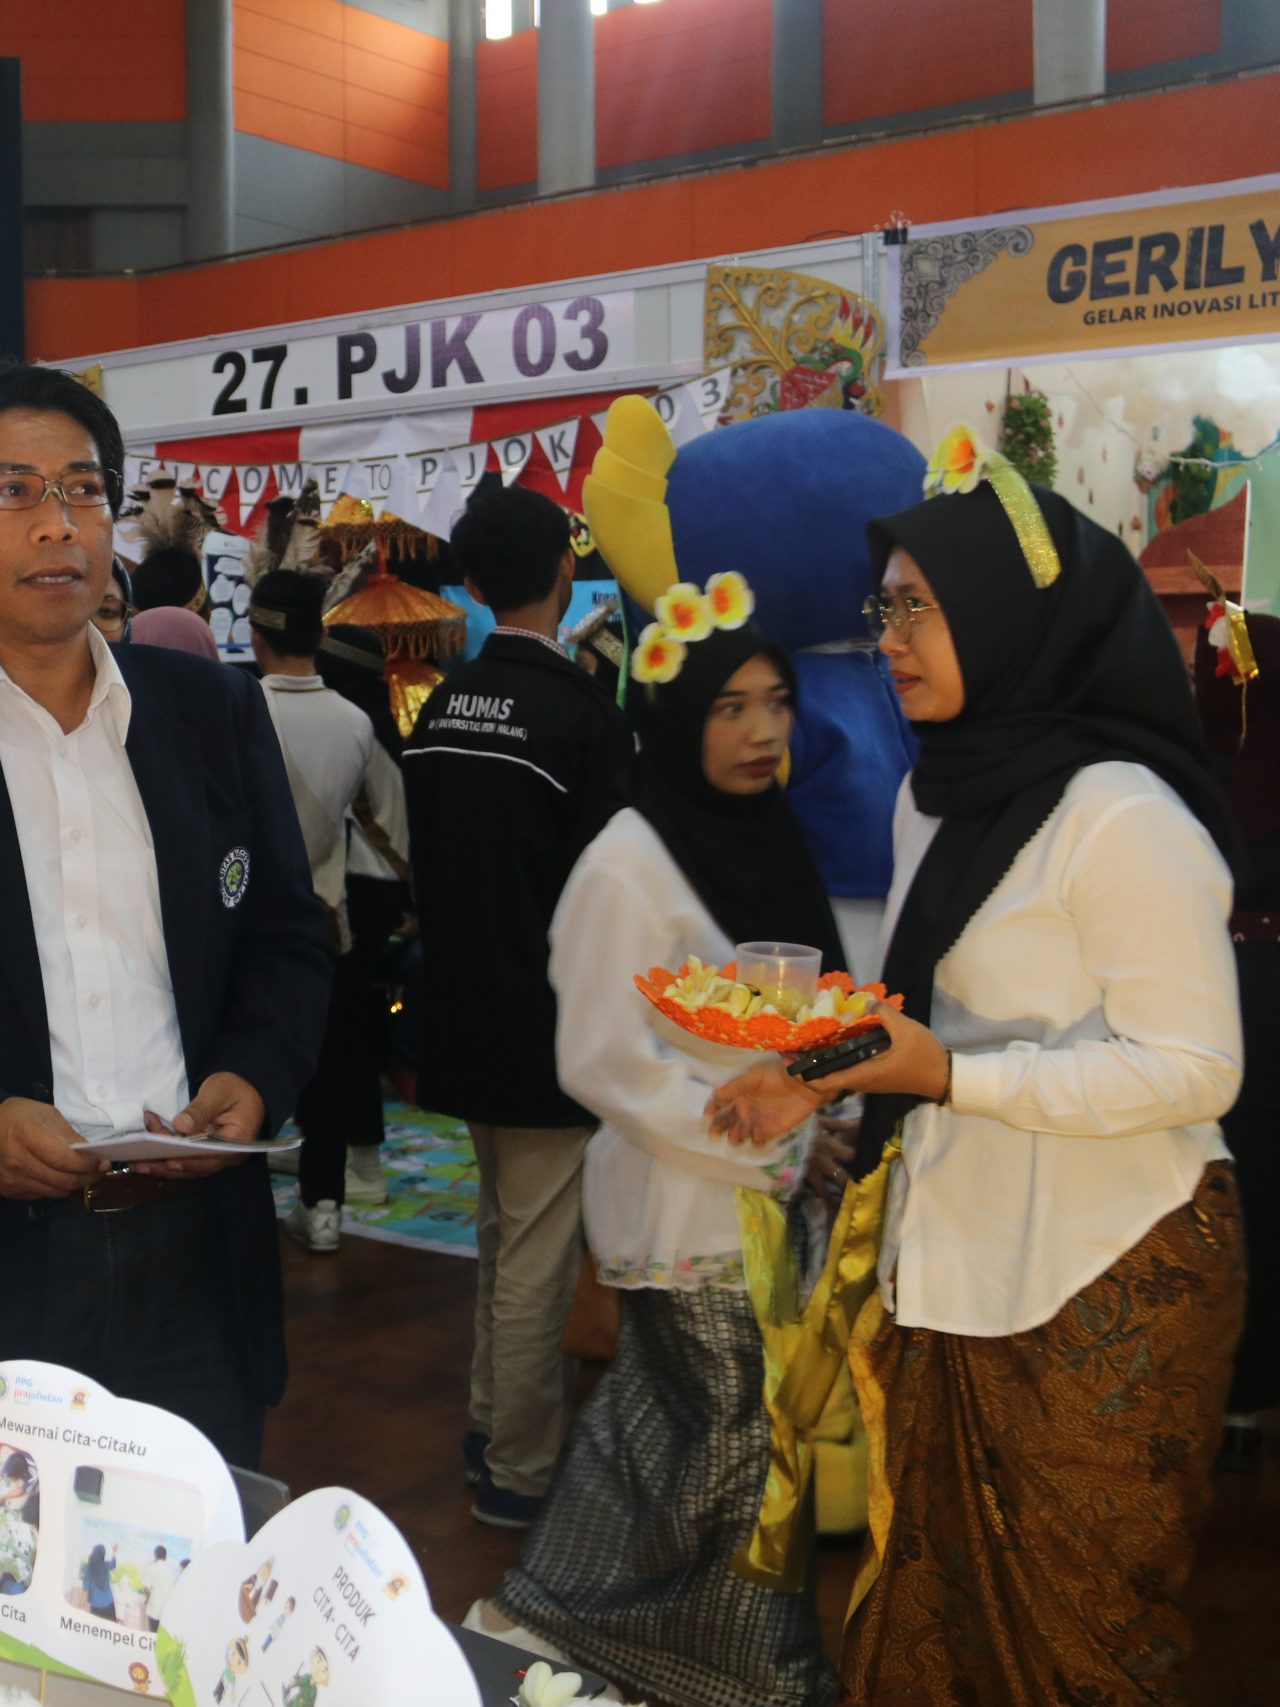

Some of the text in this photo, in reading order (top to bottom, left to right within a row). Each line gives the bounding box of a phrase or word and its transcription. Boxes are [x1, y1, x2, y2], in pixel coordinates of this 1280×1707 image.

[1083, 305, 1147, 326] GELAR
[1153, 295, 1241, 319] INOVASI
[211, 296, 609, 416] 27. PJK 03
[364, 463, 392, 491] TO
[446, 693, 515, 720] HUMAS
[62, 1429, 147, 1457] Cita-Citaku
[332, 1565, 377, 1629] PRODUK
[1, 1604, 27, 1624] Cita
[59, 1615, 135, 1648] Menempel
[334, 1623, 362, 1664] CITA
